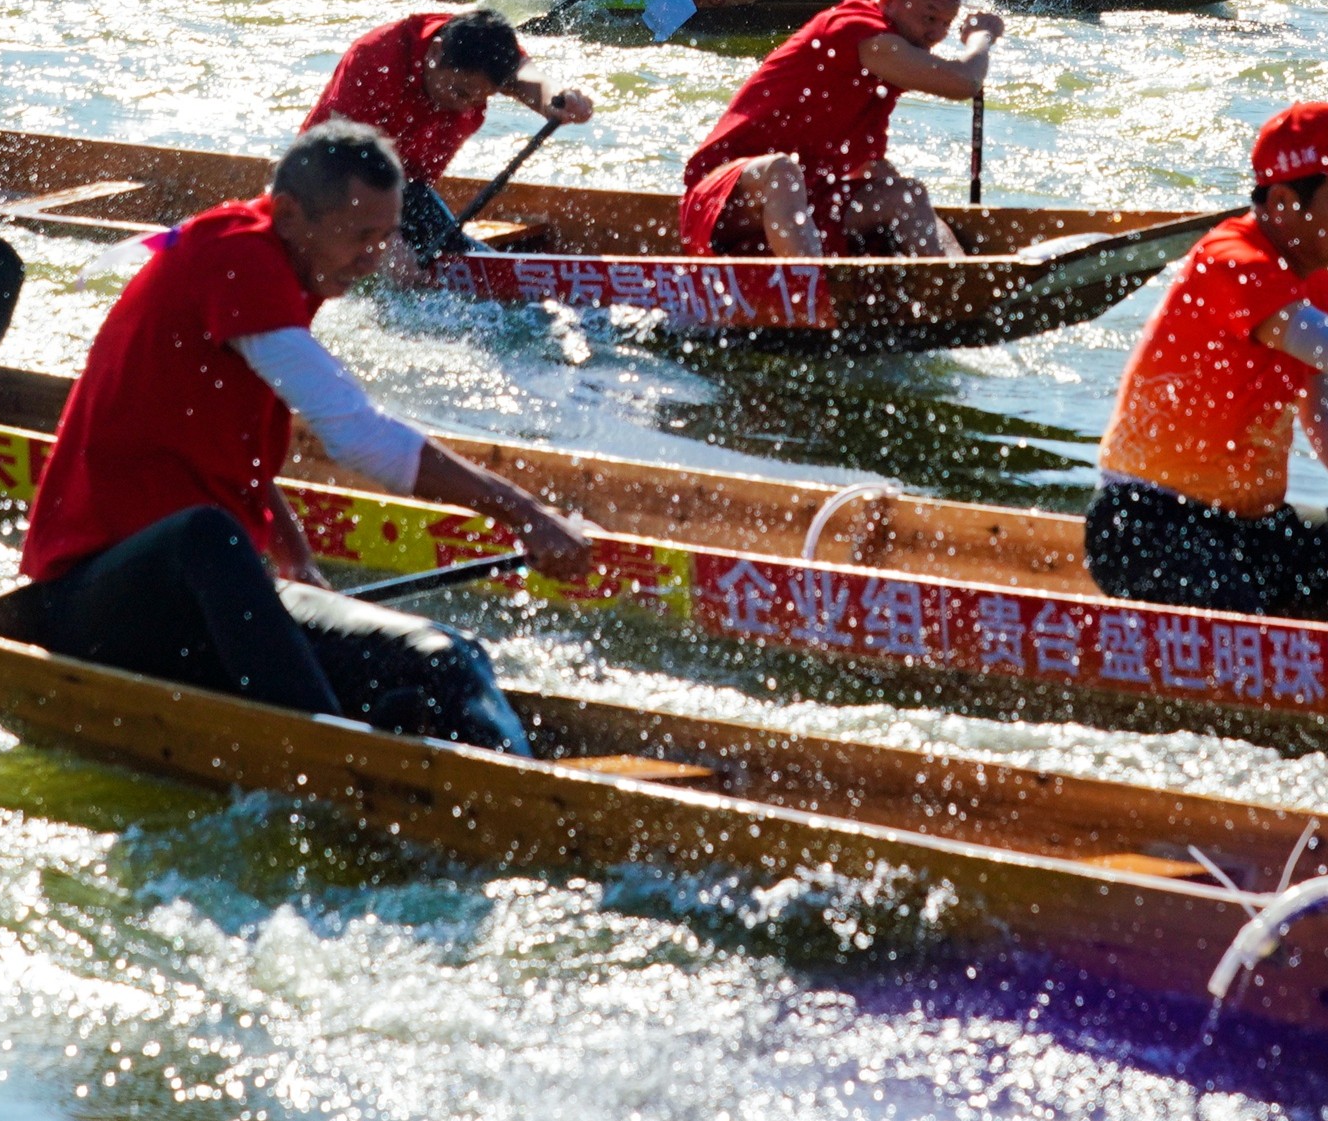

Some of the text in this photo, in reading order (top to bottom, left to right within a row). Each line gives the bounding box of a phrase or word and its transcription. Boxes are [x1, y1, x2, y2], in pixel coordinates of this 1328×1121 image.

[767, 265, 821, 325] 17
[716, 557, 928, 657] 企业组
